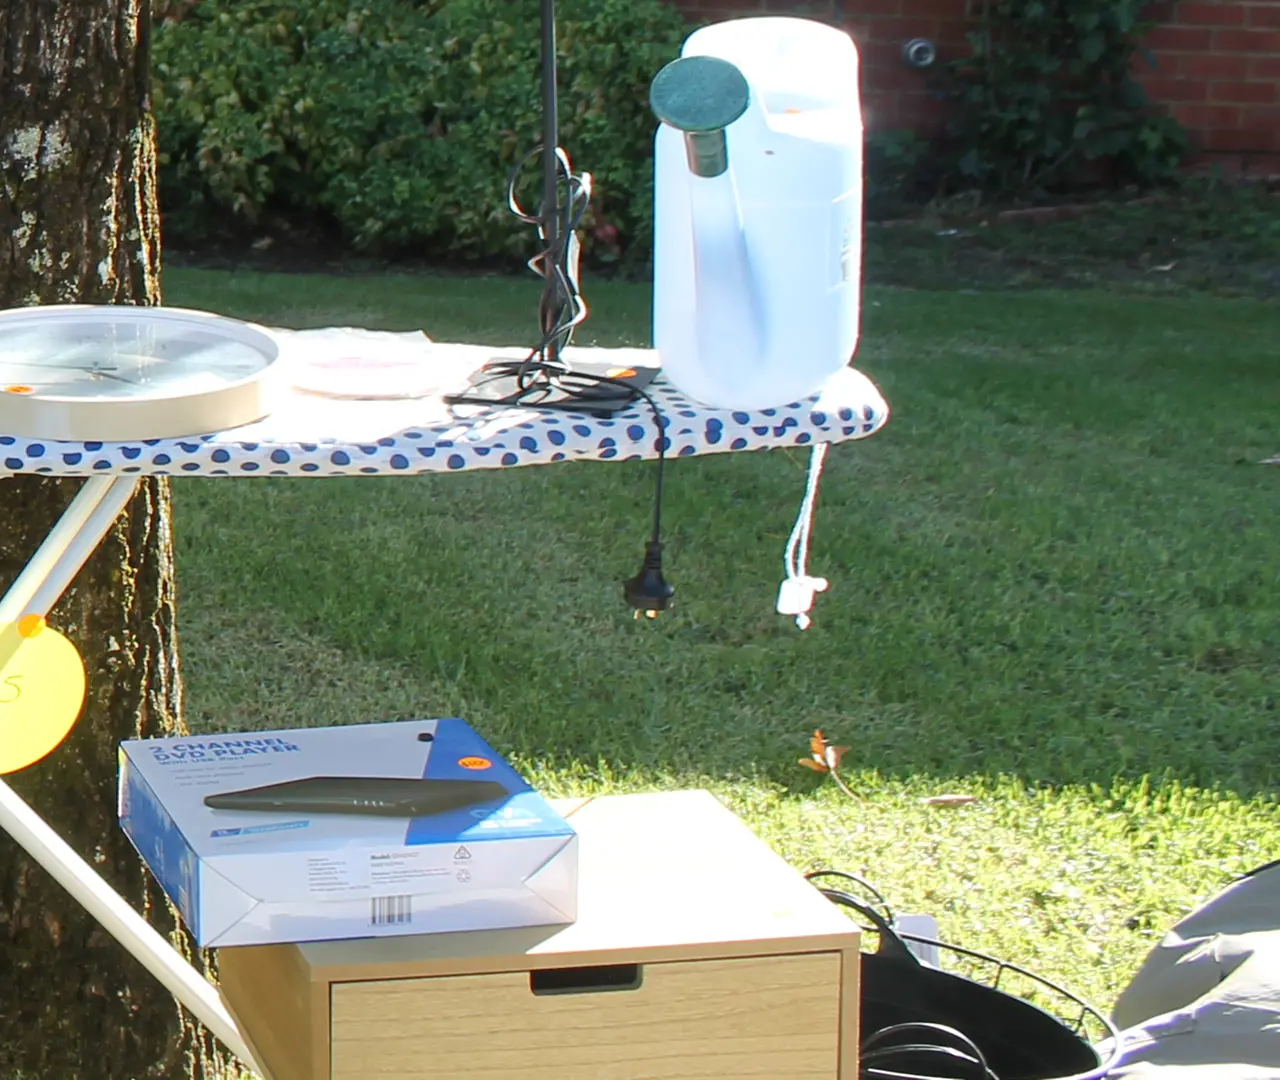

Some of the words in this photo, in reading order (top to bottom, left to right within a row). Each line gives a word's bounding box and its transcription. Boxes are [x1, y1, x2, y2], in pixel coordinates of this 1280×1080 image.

[172, 738, 289, 752] CHANNEL
[153, 750, 205, 761] DVD
[212, 745, 301, 757] PLAYER
